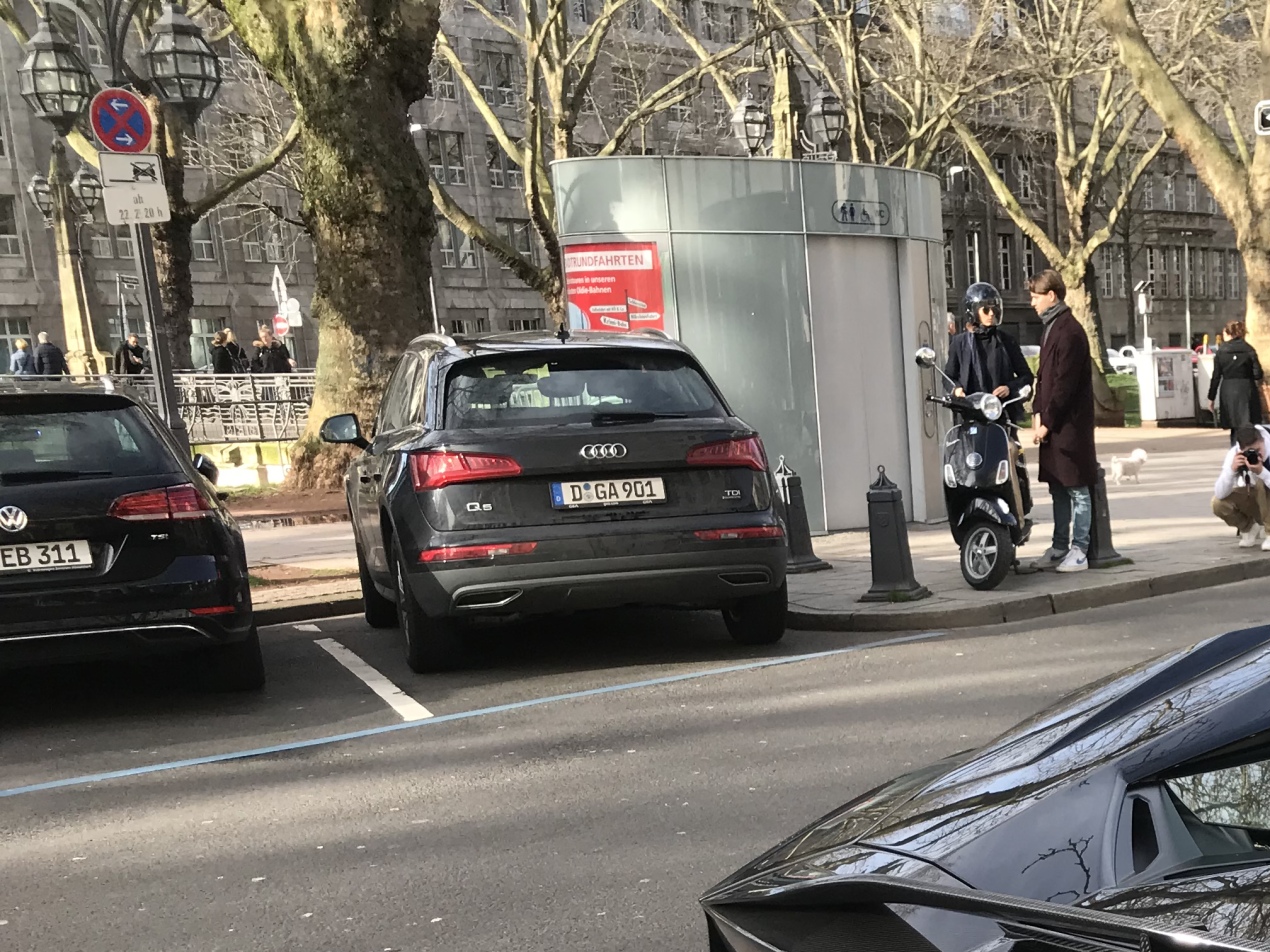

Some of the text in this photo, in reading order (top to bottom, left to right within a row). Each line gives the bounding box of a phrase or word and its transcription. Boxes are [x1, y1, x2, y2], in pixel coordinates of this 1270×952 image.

[133, 193, 144, 205] ab
[571, 480, 656, 502] D GA 901
[466, 502, 492, 512] Q5
[1, 543, 81, 567] EB 311
